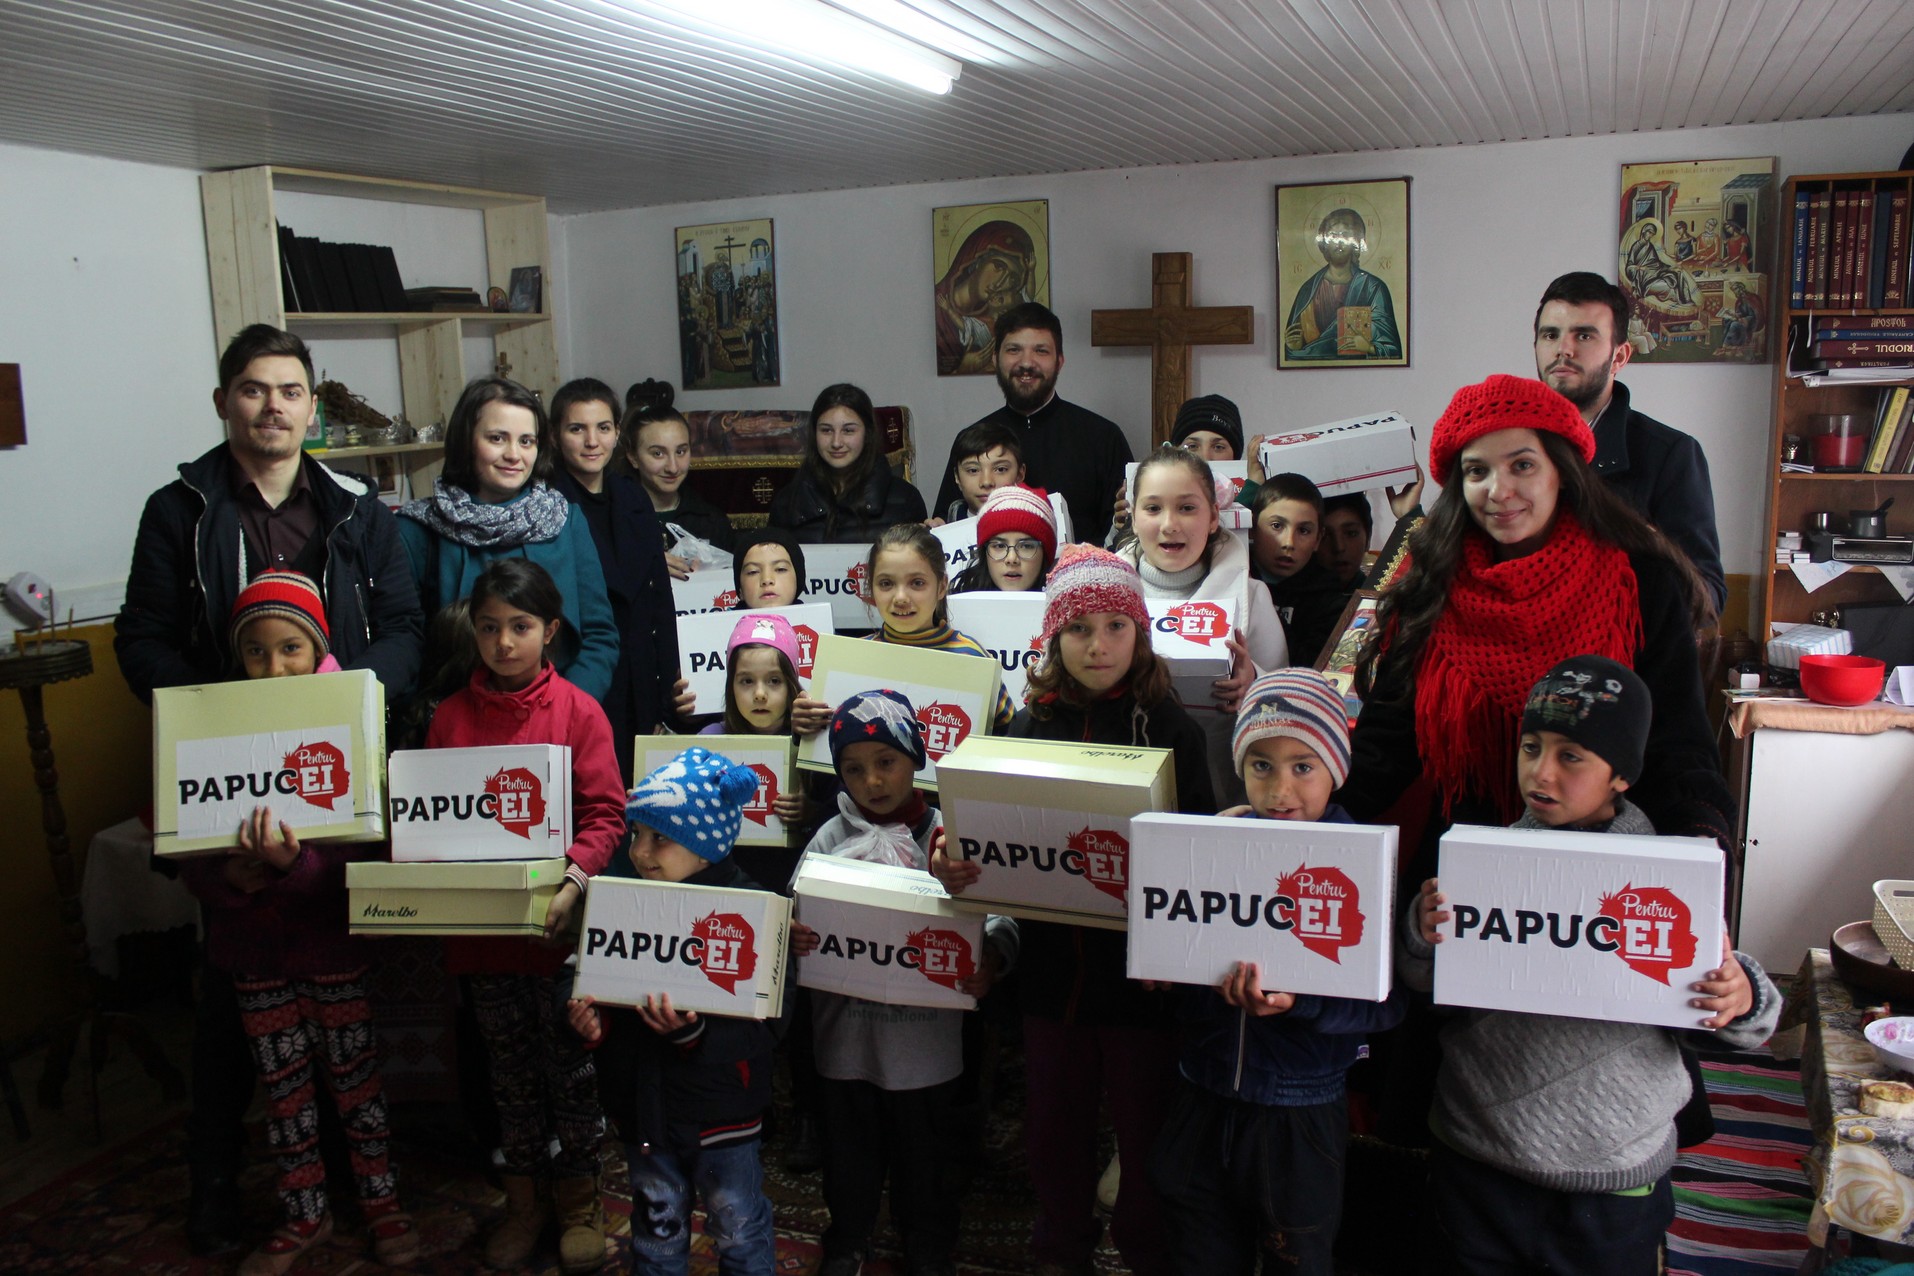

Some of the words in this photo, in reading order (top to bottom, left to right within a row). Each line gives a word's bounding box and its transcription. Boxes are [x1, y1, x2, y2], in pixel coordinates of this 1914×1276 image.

[1179, 604, 1218, 617] Pentru
[928, 706, 963, 727] Pentru
[295, 749, 336, 766] Pentru
[496, 774, 533, 792] Pentru
[1081, 833, 1126, 855] Pentru
[1293, 873, 1348, 899] Pentru
[1617, 893, 1678, 920] Pentru
[706, 918, 746, 940] Pentru
[920, 932, 962, 951] Pentru
